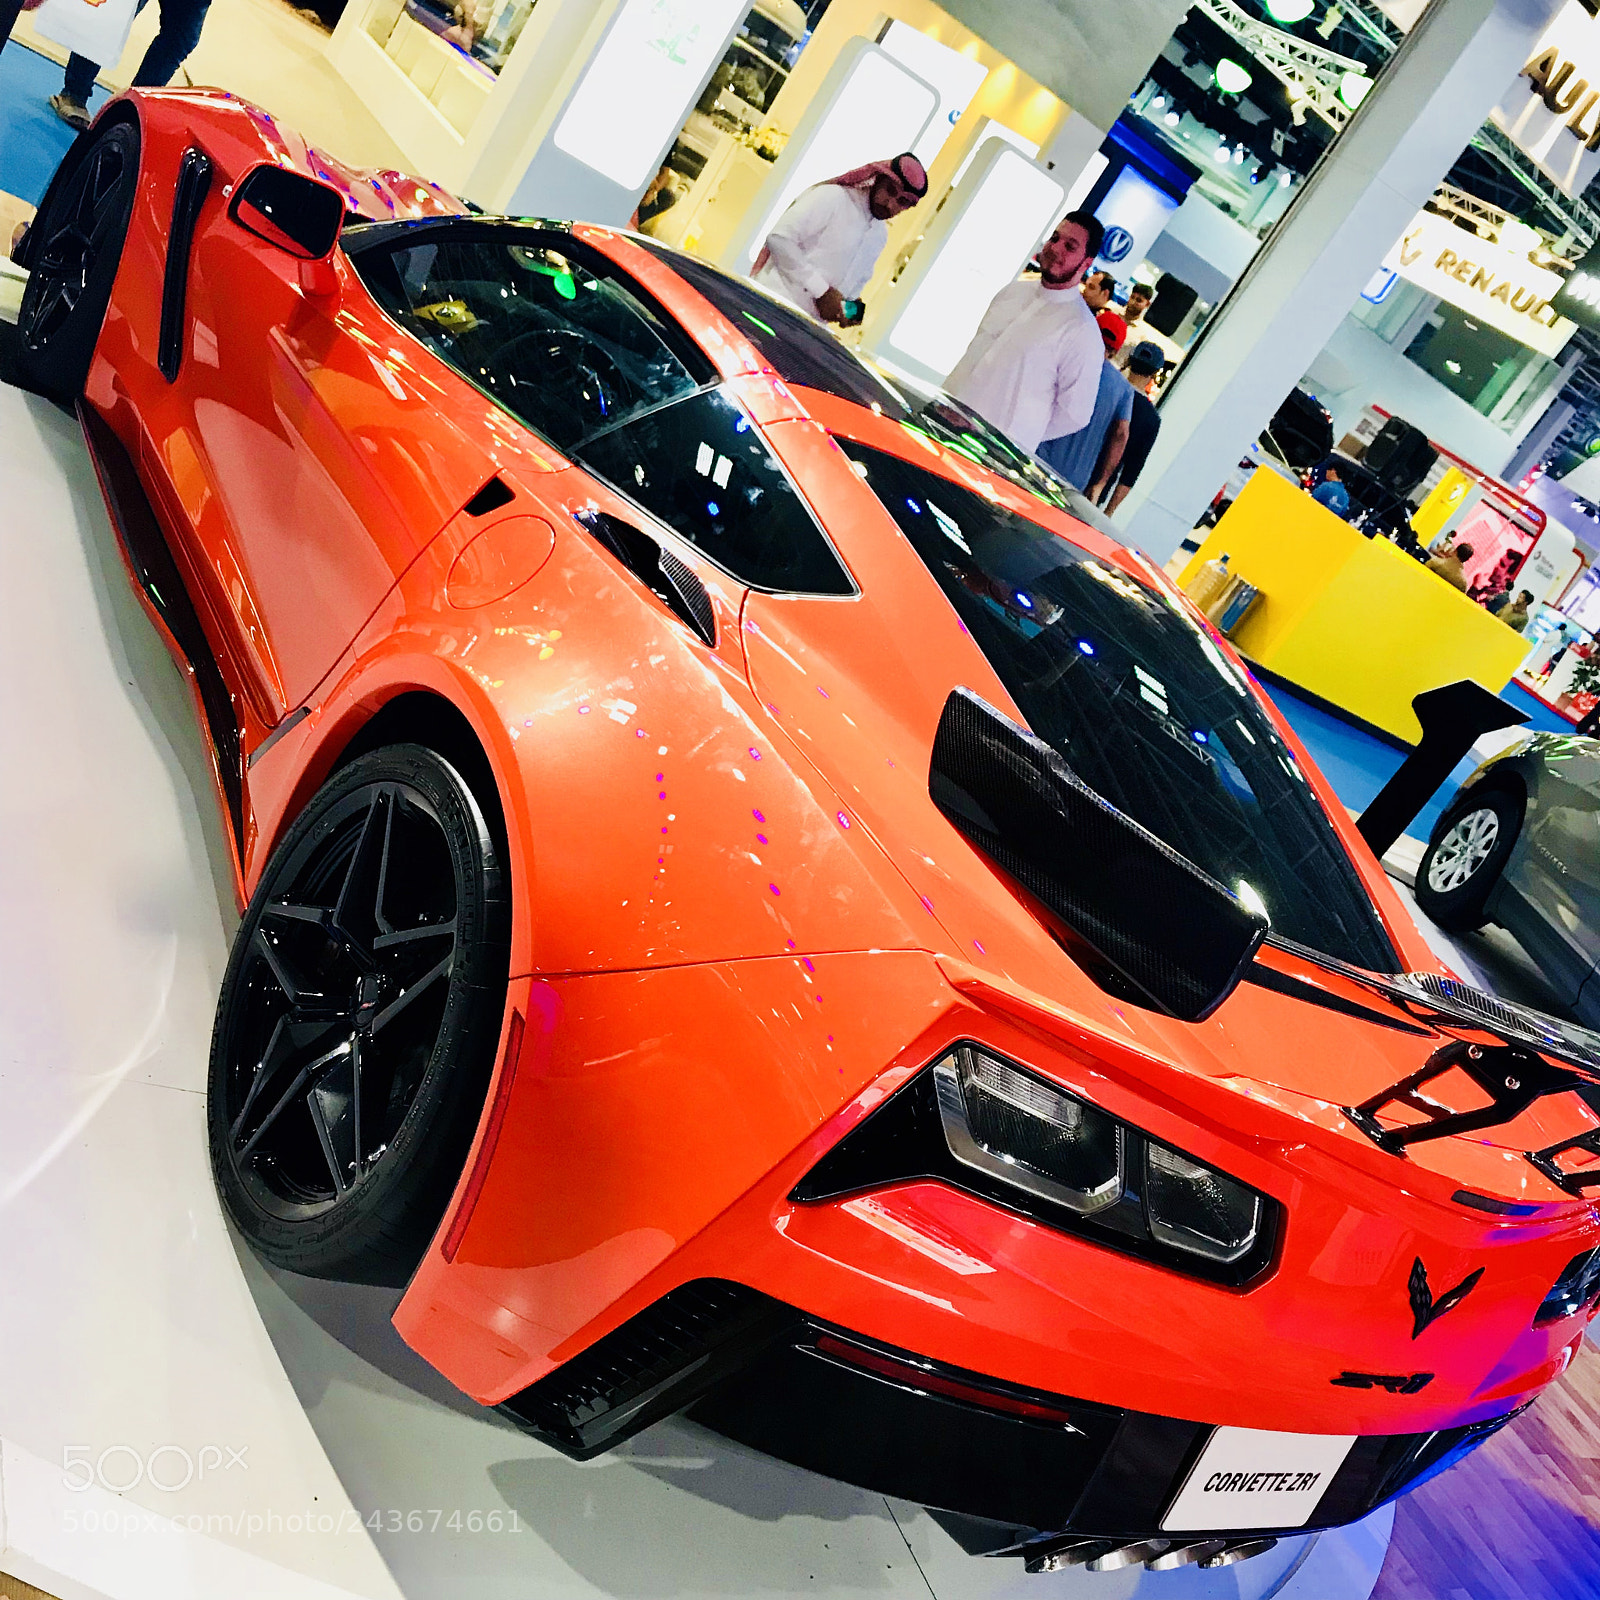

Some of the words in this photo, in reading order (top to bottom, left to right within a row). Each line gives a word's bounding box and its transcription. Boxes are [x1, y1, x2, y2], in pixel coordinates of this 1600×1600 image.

[1518, 46, 1600, 153] AUL
[1203, 1471, 1293, 1492] CORVETTE
[1285, 1471, 1322, 1492] ZR1
